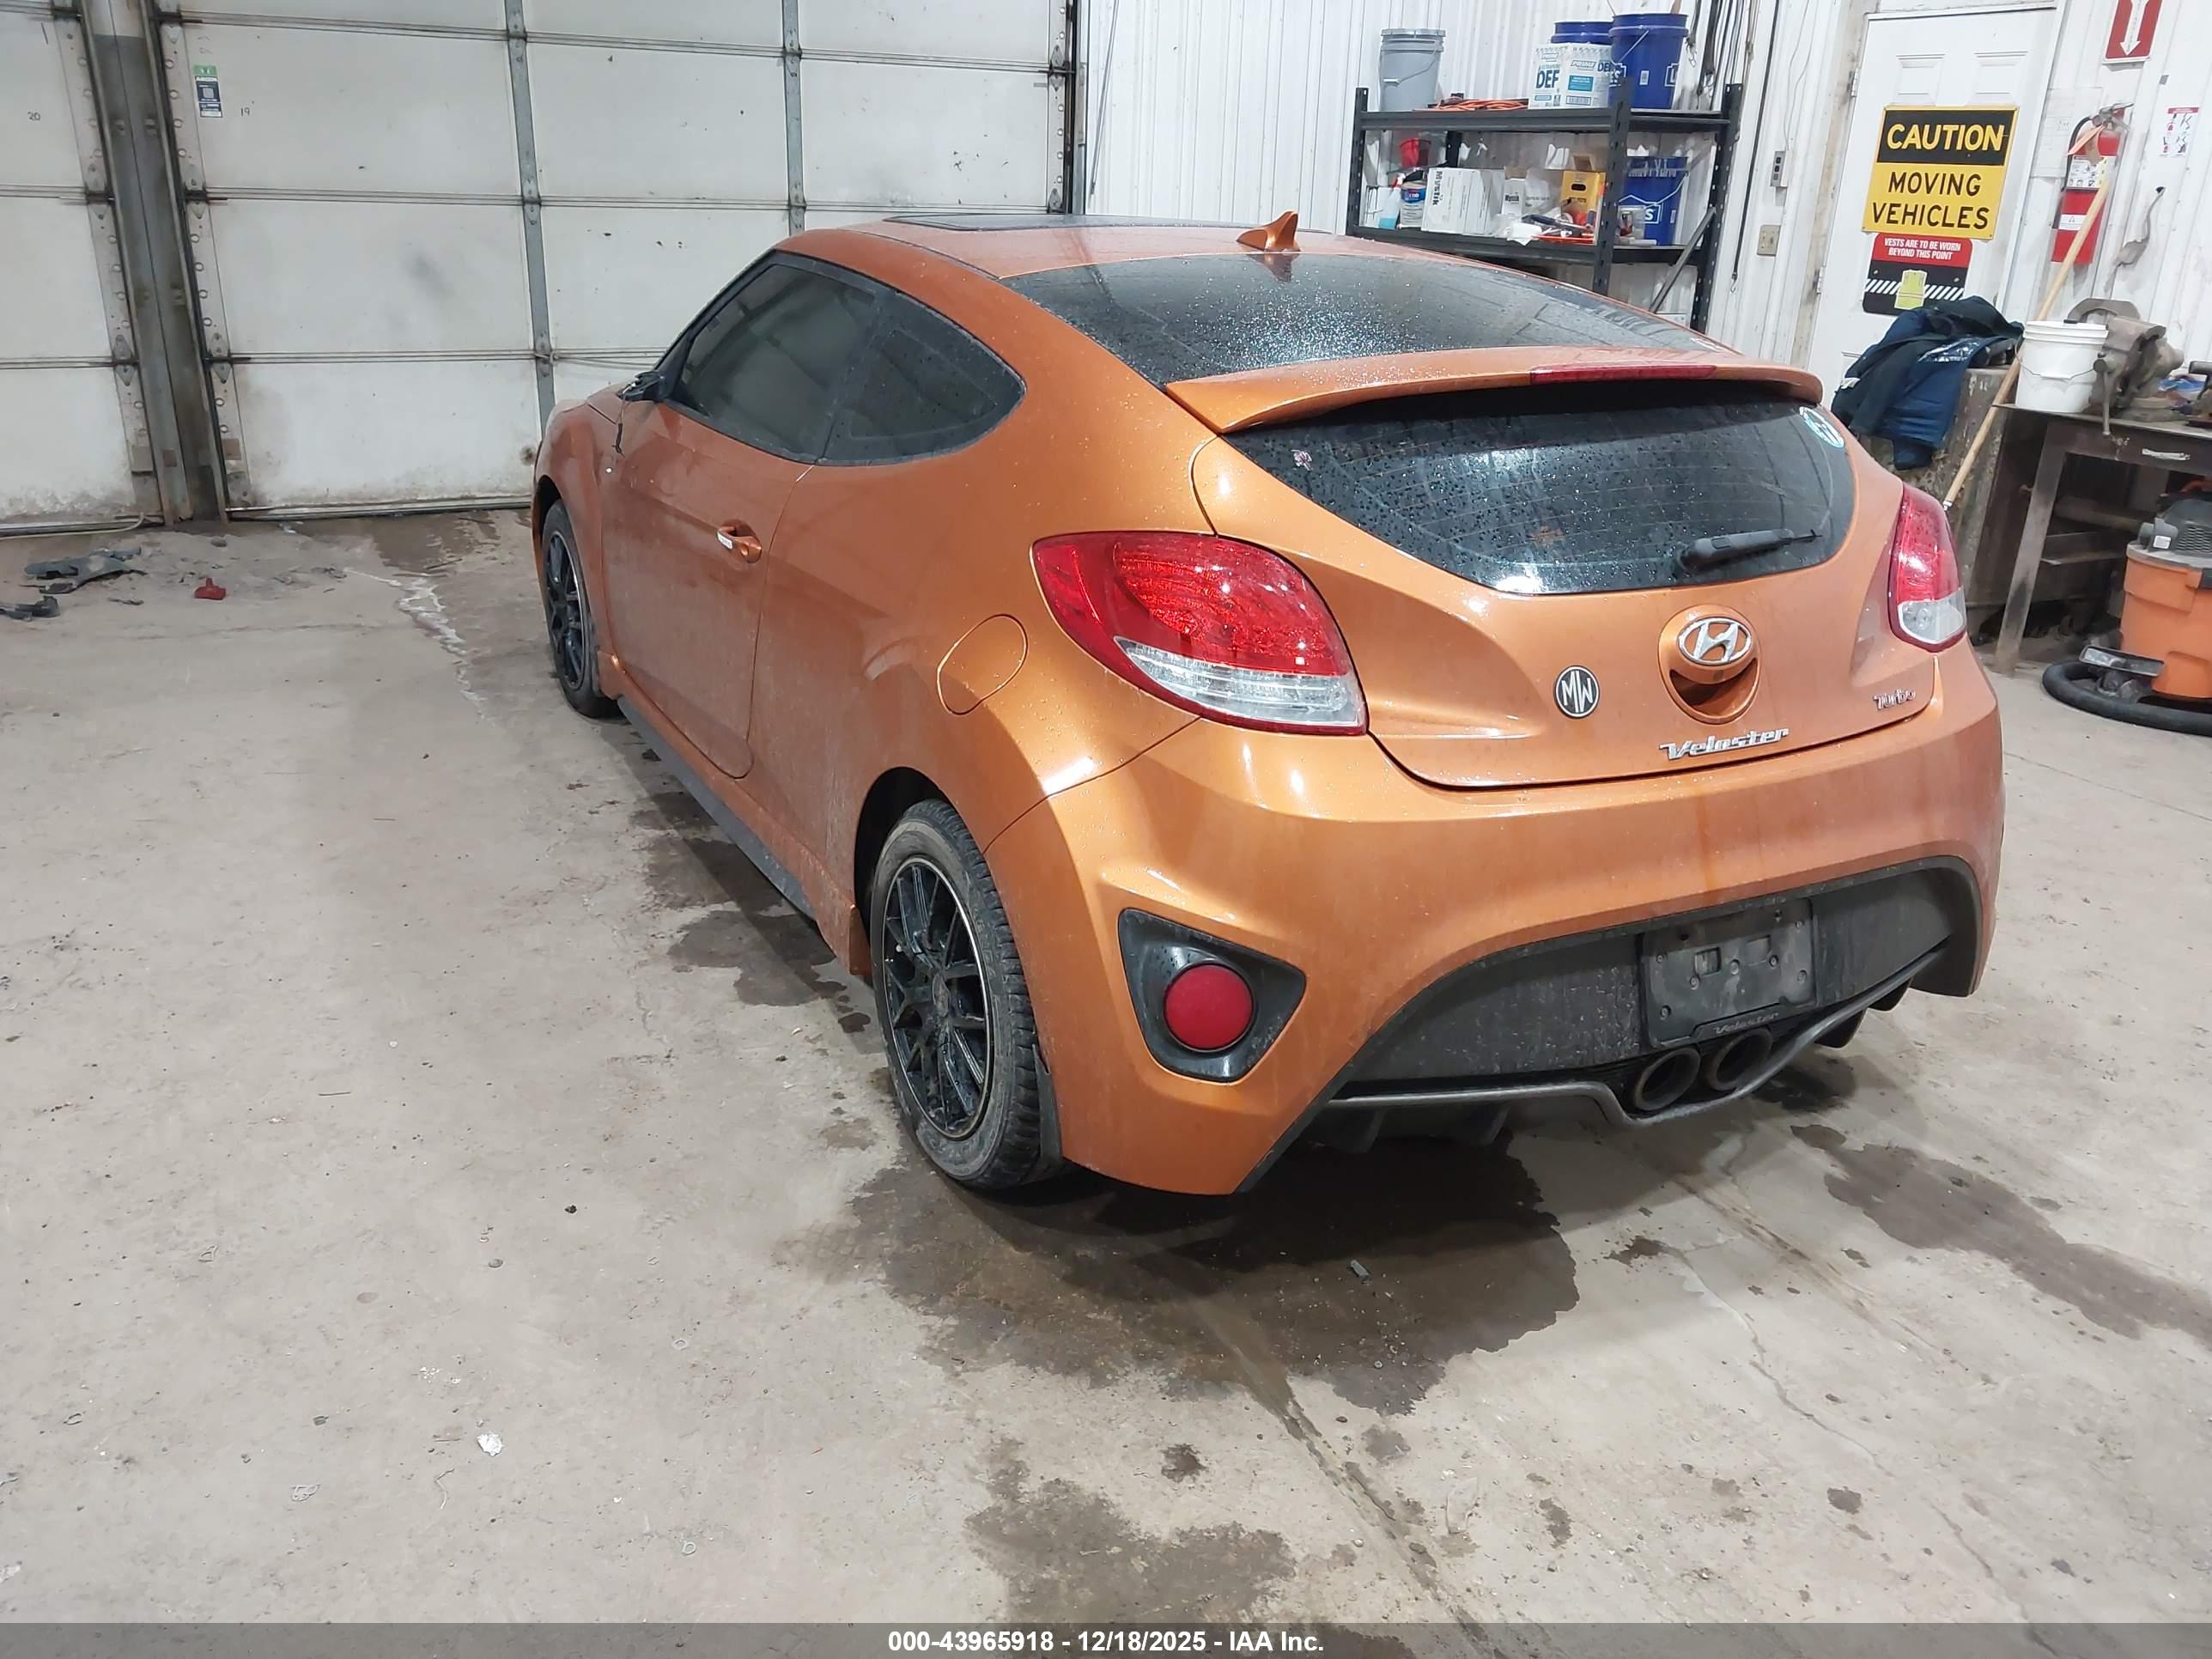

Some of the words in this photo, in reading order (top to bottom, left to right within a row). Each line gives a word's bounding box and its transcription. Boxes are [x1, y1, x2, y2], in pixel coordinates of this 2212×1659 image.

[1536, 70, 1560, 88] DEF
[1597, 62, 1611, 72] DE
[27, 112, 41, 120] 20
[1887, 124, 2005, 151] CAUTION
[1432, 171, 1443, 206] Mystik
[1888, 172, 1982, 196] MOVING
[1873, 202, 1990, 230] VEHICLES
[1884, 238, 1905, 247] VESTS
[1905, 239, 1919, 248] ARE
[1920, 240, 1929, 249] TO
[1929, 241, 1939, 250] BE
[1939, 241, 1961, 252] WORN
[1888, 247, 1915, 258] BEYOND
[1916, 249, 1931, 258] THIS
[1931, 251, 1953, 260] POINT
[1559, 669, 1595, 715] MW
[1659, 728, 1790, 759] Veloster
